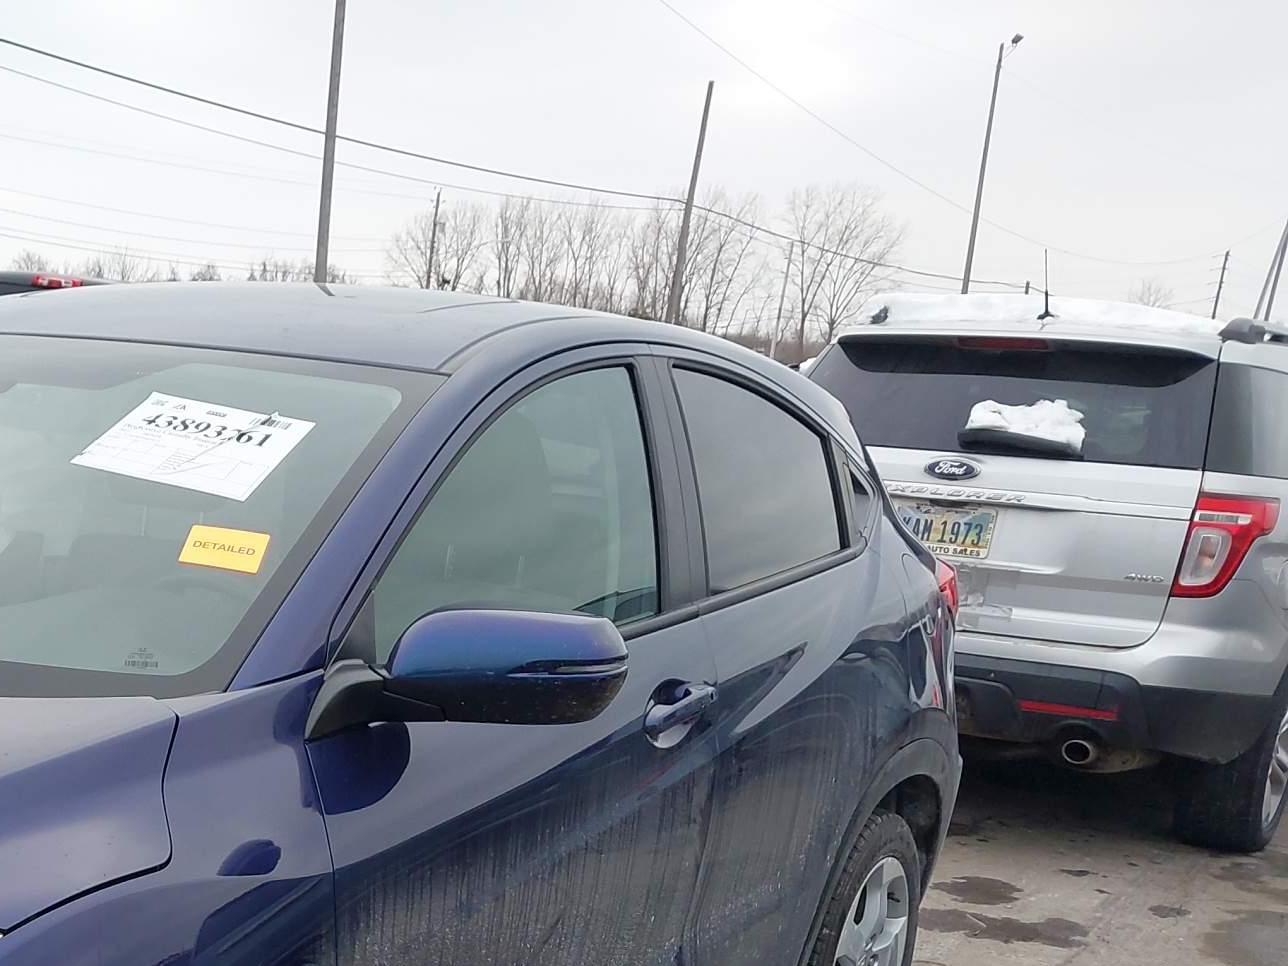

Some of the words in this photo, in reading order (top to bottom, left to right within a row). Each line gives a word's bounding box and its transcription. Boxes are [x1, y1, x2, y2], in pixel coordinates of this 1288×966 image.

[934, 460, 969, 476] Ford
[886, 483, 1027, 503] XPLORER
[937, 520, 984, 547] 1973
[192, 540, 256, 556] DETAILED
[927, 544, 950, 555] AUTO
[952, 547, 981, 558] SALES
[1124, 572, 1165, 584] 4WD
